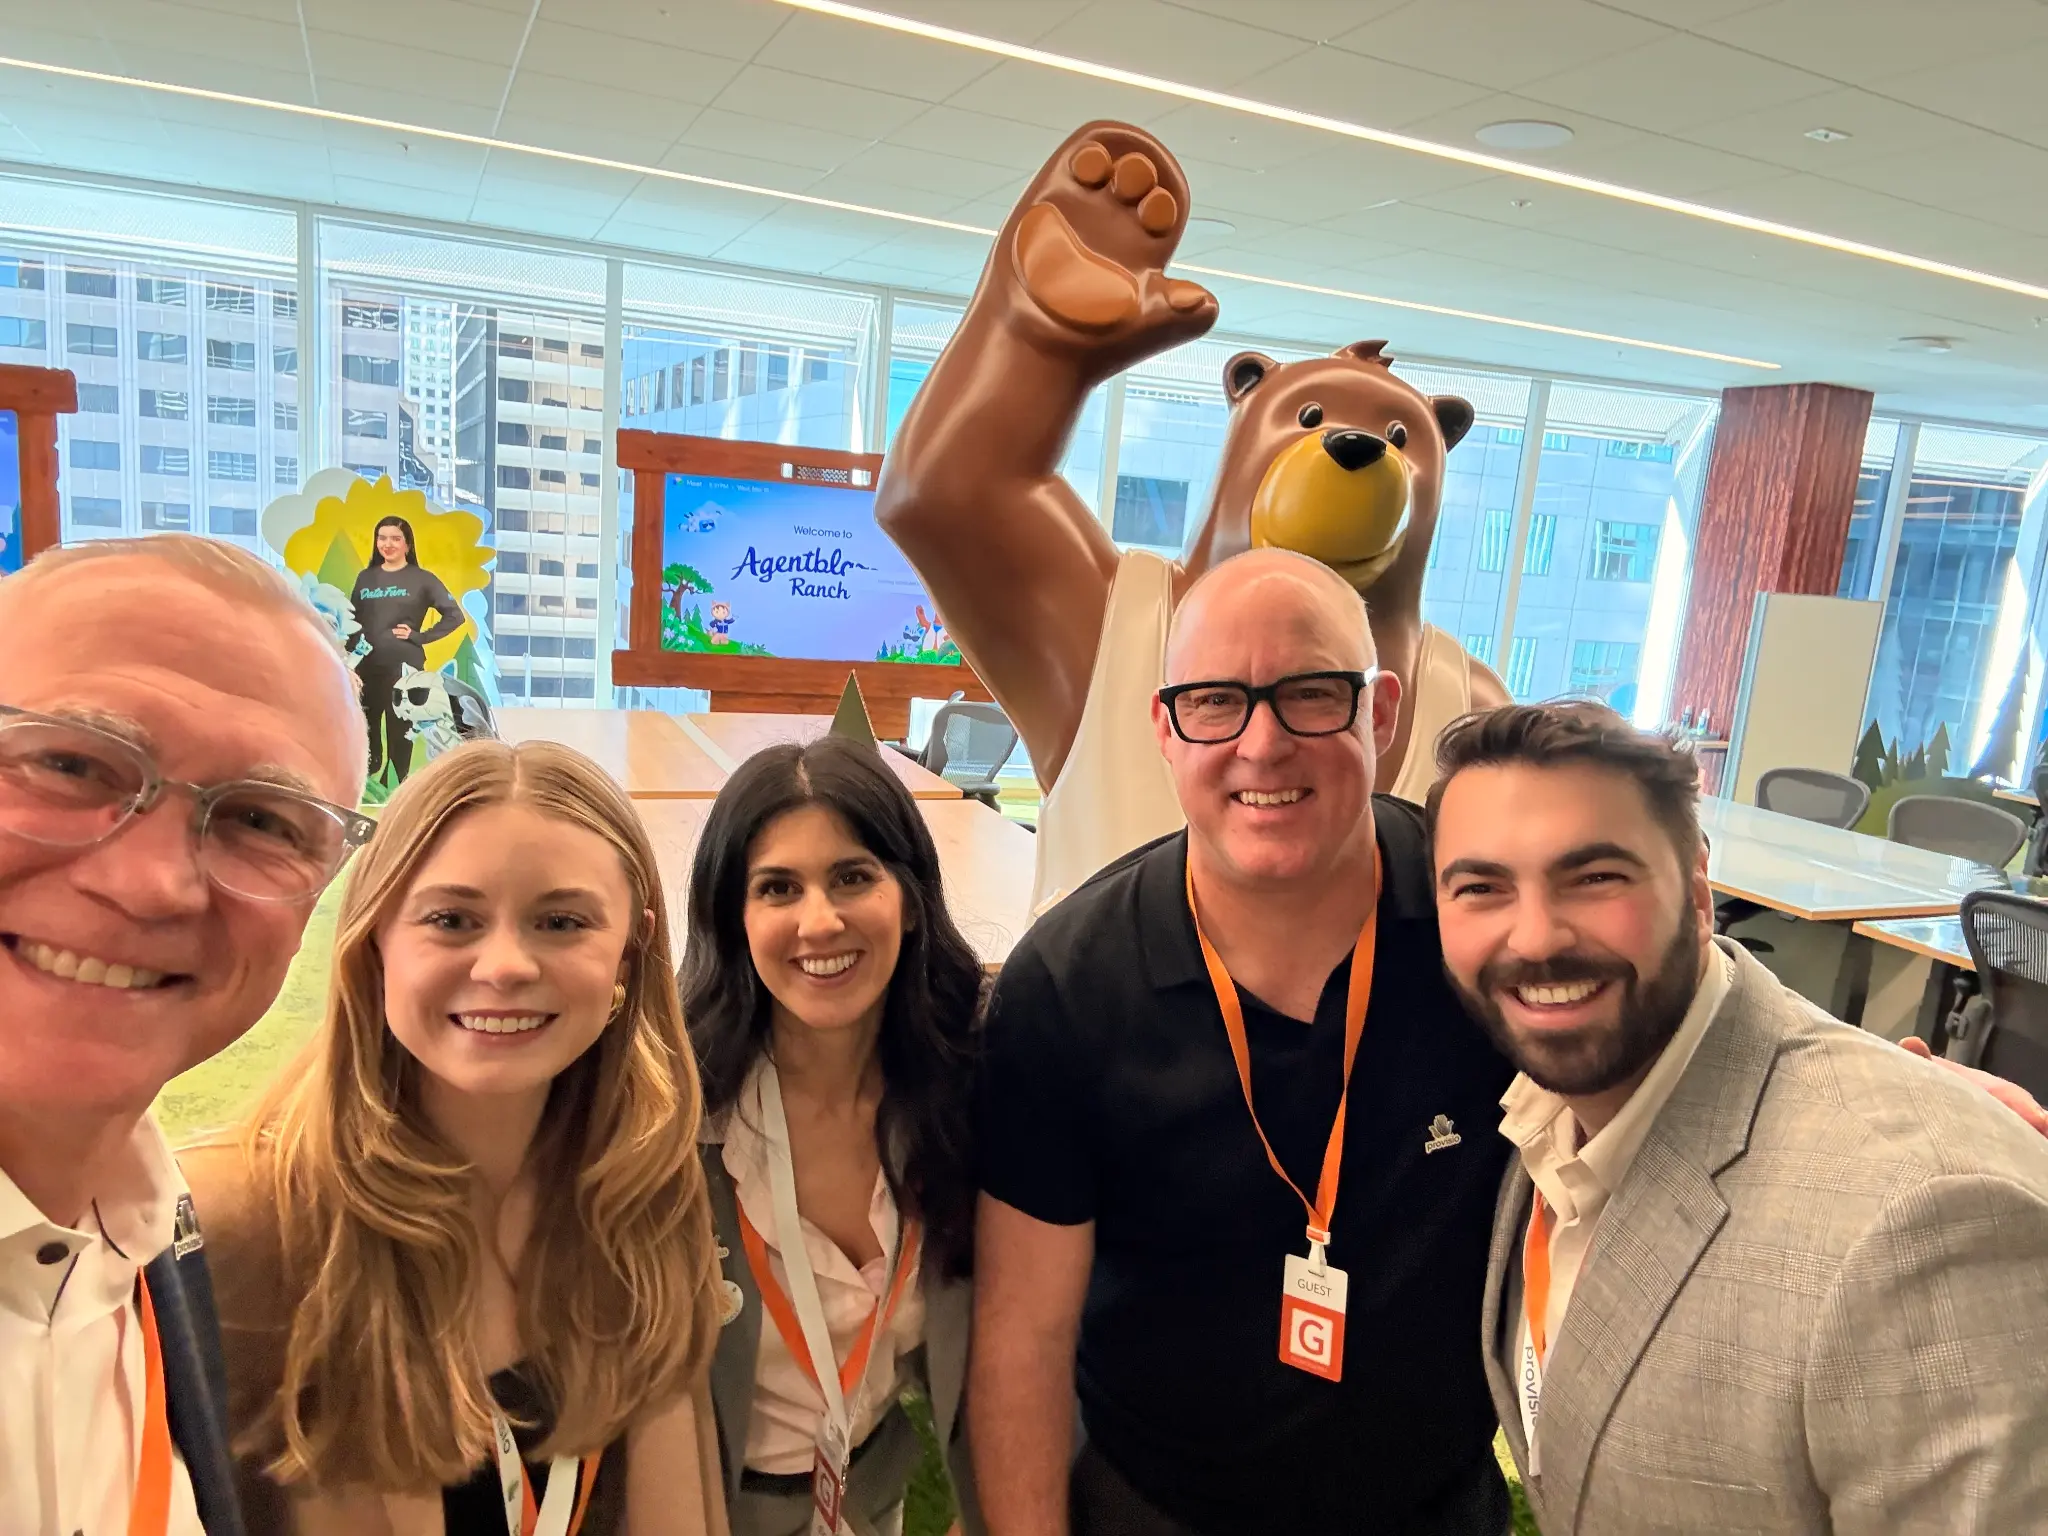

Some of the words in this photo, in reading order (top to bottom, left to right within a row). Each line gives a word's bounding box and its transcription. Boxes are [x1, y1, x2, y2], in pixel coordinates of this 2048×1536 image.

[794, 525, 841, 539] Welcome
[843, 529, 853, 539] to
[789, 577, 851, 600] Ranch
[1427, 1135, 1460, 1152] provisio
[1297, 1278, 1332, 1298] GUEST
[1298, 1319, 1324, 1356] G
